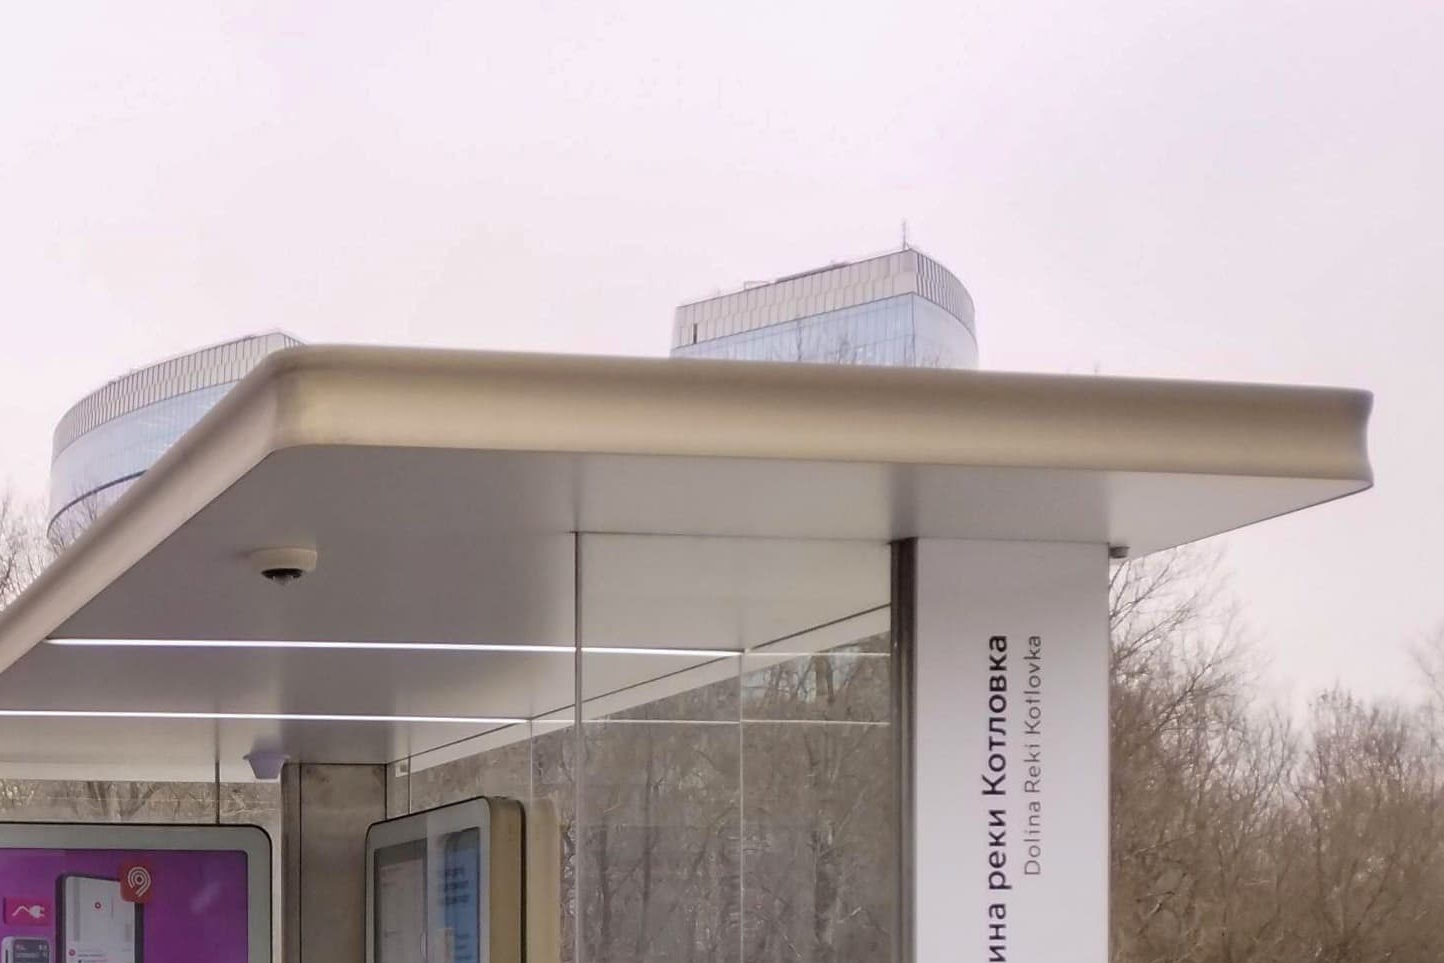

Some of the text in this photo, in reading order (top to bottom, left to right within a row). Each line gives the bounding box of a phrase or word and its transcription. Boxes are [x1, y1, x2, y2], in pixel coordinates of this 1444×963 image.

[981, 635, 1008, 796] Котловка
[1023, 635, 1041, 876] Dolina Reki Kotlovka
[988, 809, 1012, 890] реки
